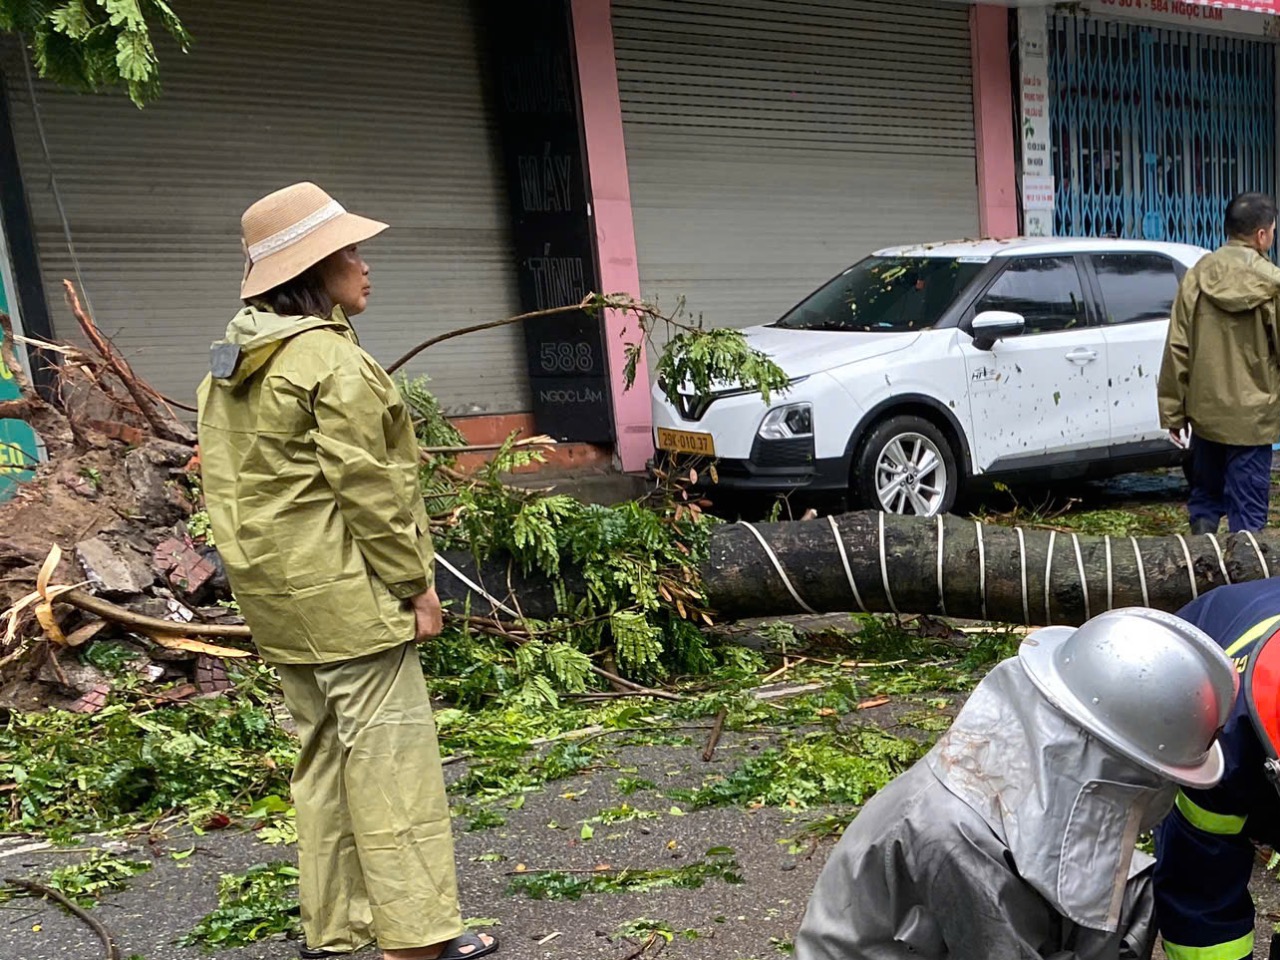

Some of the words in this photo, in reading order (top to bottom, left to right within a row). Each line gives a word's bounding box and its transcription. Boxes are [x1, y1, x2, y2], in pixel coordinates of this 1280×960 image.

[1171, 2, 1199, 20] NGỌC
[540, 343, 593, 372] 588
[540, 391, 575, 404] NGỌC
[576, 388, 602, 402] LÂM
